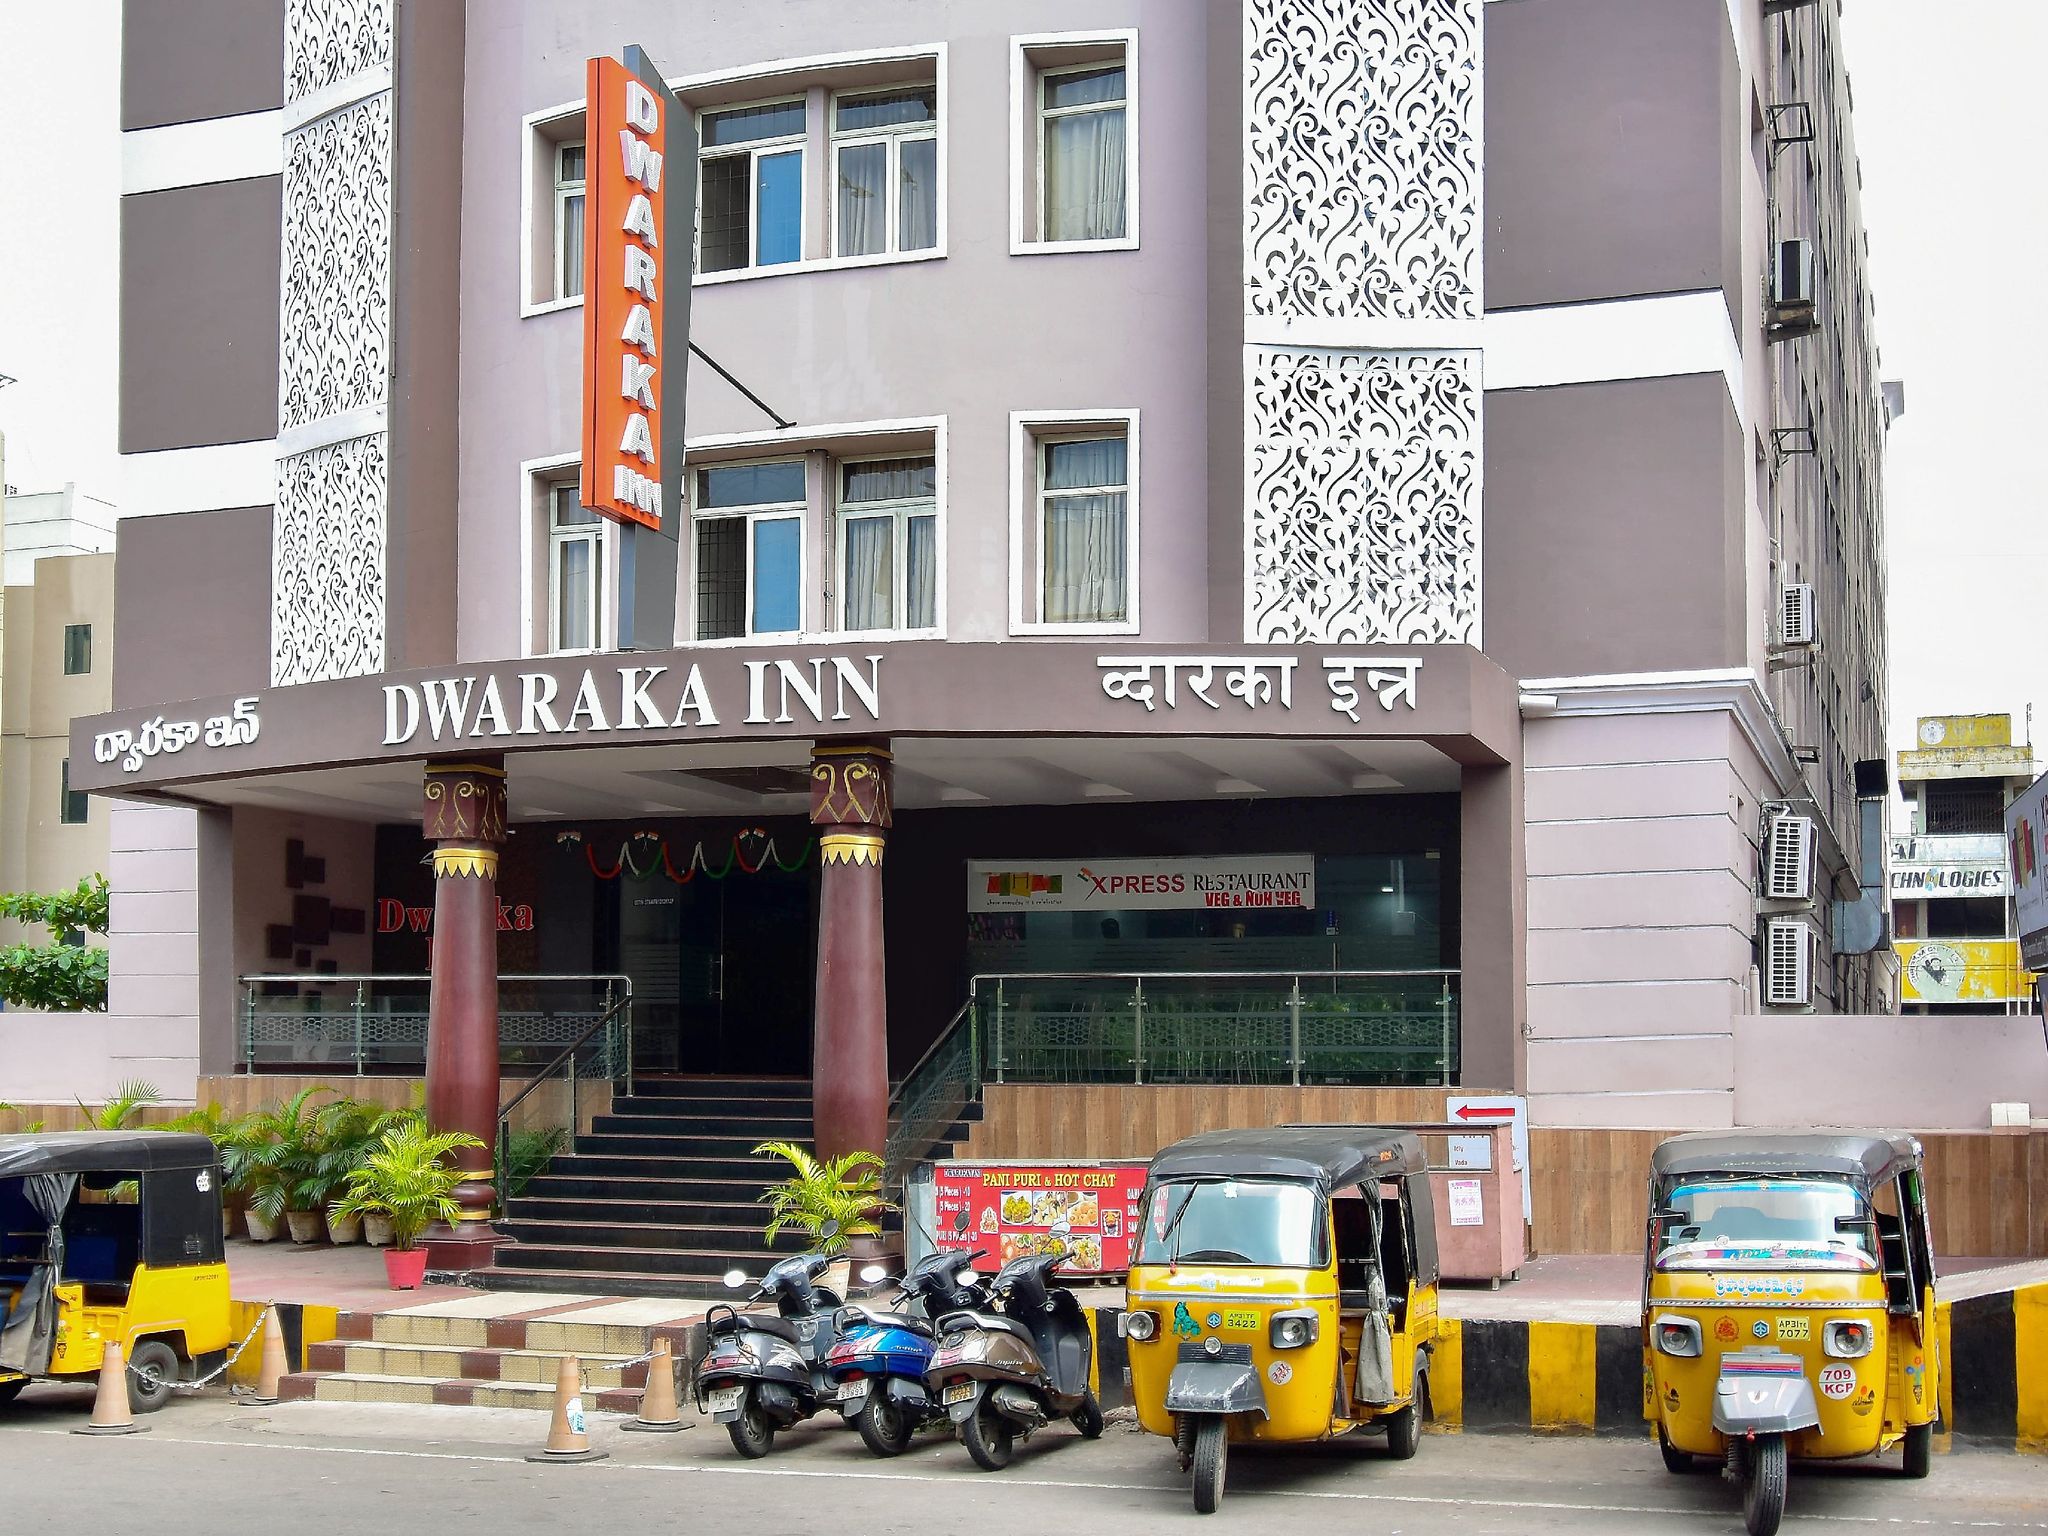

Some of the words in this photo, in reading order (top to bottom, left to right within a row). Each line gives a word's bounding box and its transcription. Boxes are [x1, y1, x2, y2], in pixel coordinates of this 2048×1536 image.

[619, 80, 663, 464] DWARAKA
[613, 464, 663, 518] INN
[380, 662, 721, 745] DWARAKA
[741, 654, 885, 725] INN
[1193, 872, 1311, 891] RESTAURANT
[1205, 892, 1229, 907] VEG
[1233, 894, 1242, 906] &
[377, 895, 535, 932] Dwka
[983, 1173, 1010, 1187] PANI
[1014, 1173, 1041, 1187] PURI
[1044, 1177, 1052, 1187] &
[1054, 1173, 1080, 1187] HOT
[1083, 1173, 1116, 1187] CHAT
[1228, 1320, 1256, 1328] 3422
[1779, 1329, 1808, 1337] 7077
[1823, 1369, 1851, 1380] 709
[1825, 1382, 1853, 1394] KCP
